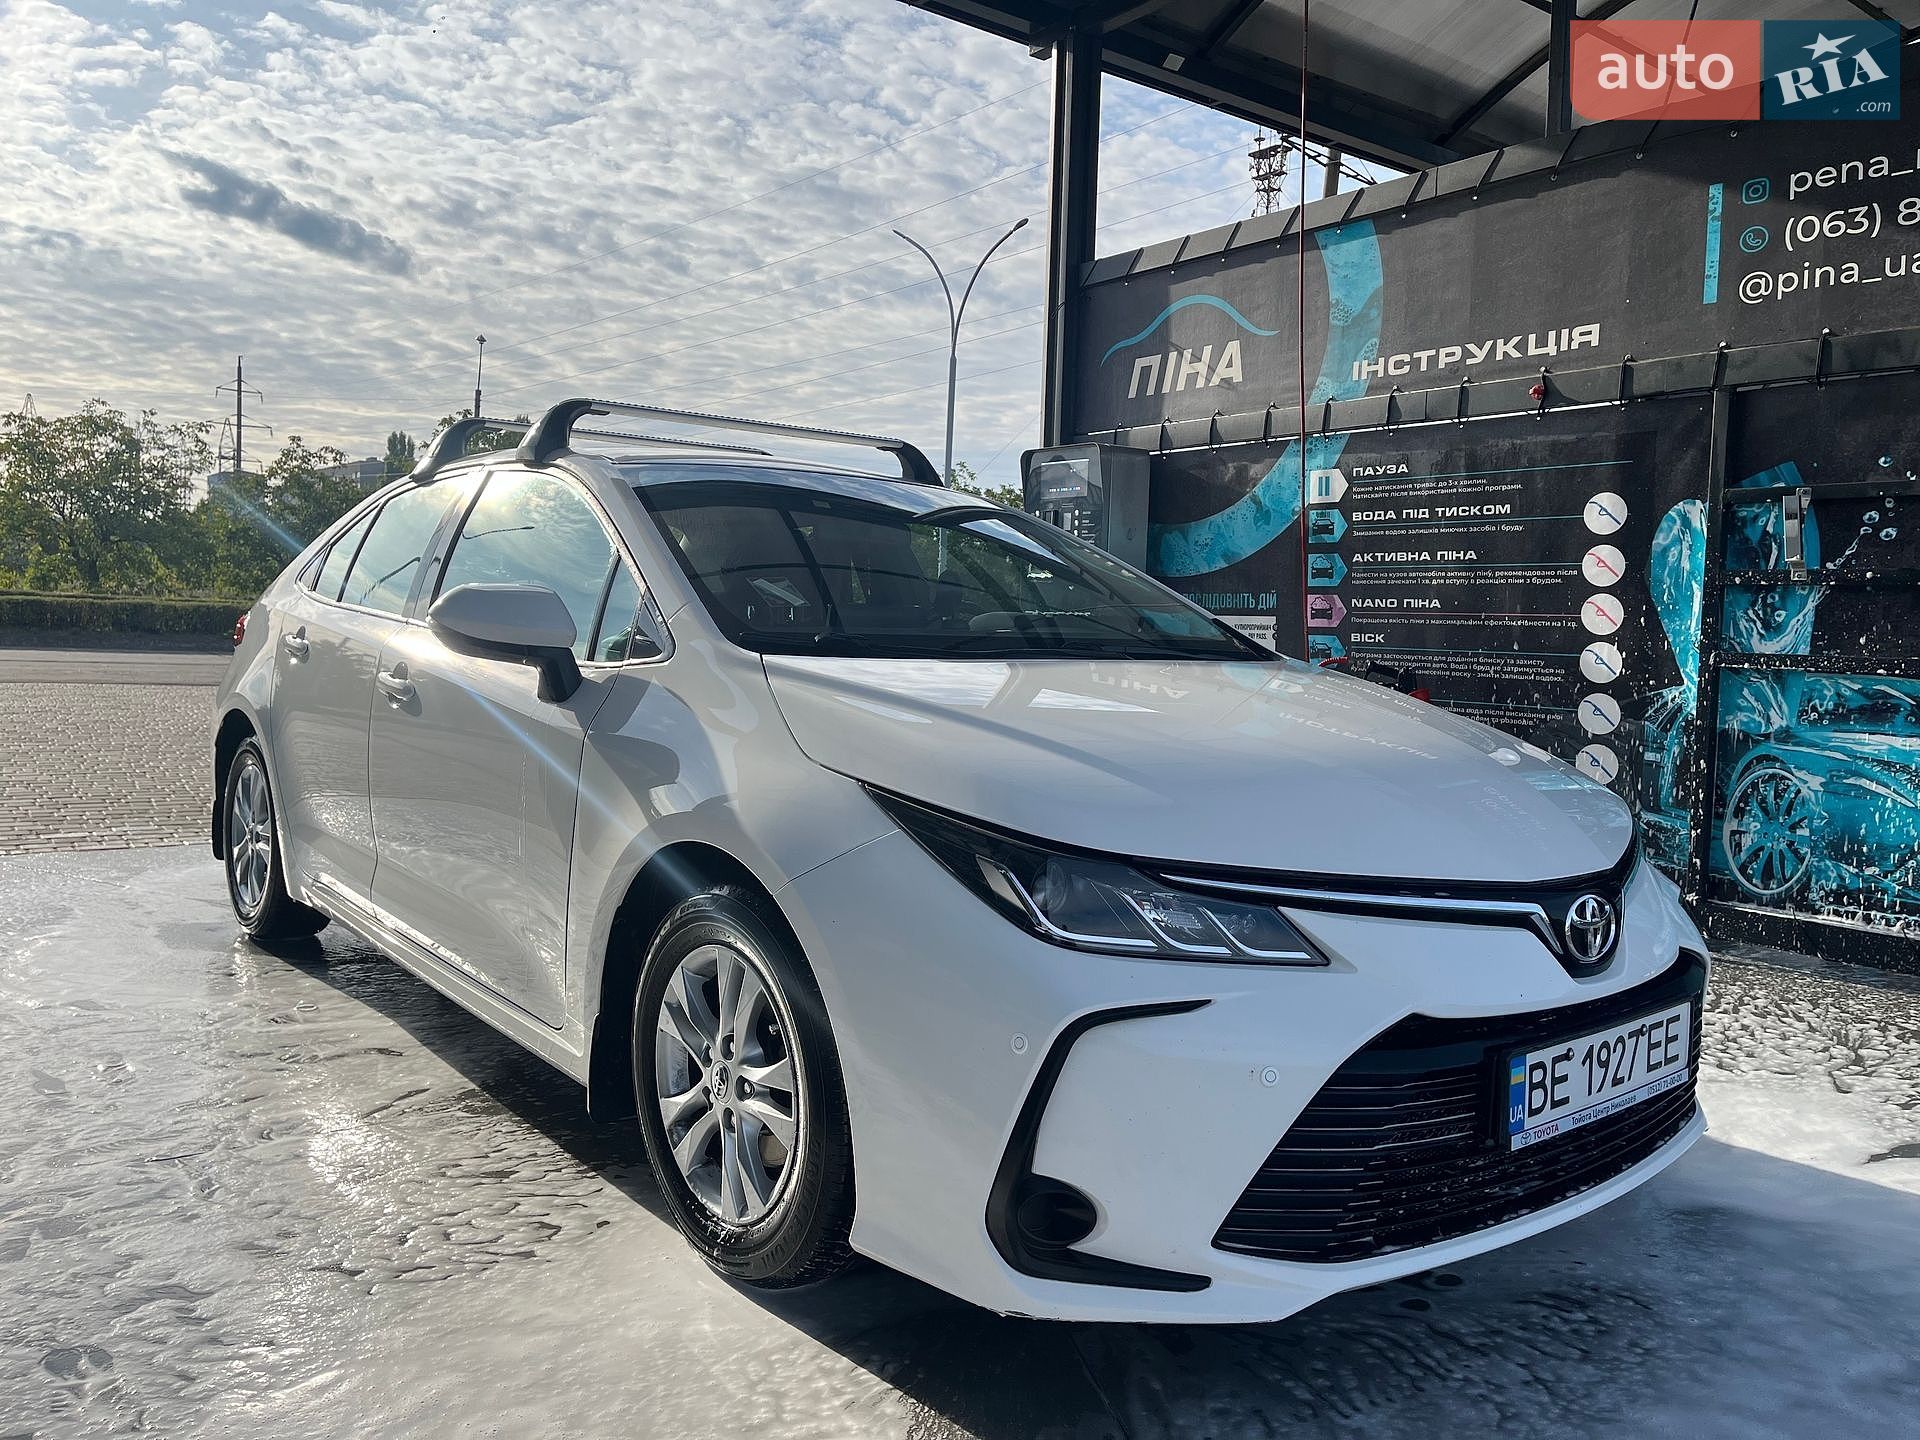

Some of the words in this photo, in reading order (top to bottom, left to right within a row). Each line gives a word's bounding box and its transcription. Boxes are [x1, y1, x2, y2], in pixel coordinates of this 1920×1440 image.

[1789, 147, 1920, 200] pena_
[1784, 203, 1882, 252] (063)
[1352, 323, 1601, 382] ІНСТРУКЦІЯ
[1127, 340, 1243, 399] ПІНА
[1352, 463, 1409, 477] ПАУЗА
[1374, 483, 1412, 492] натискання
[1390, 490, 1408, 498] після
[1409, 487, 1456, 496] використання
[1458, 485, 1484, 494] кожної
[1352, 510, 1397, 521] ВОДА
[1402, 507, 1430, 520] ПІД
[1435, 503, 1511, 518] ТИСКОМ
[1385, 529, 1406, 537] водою
[1407, 527, 1439, 535] залишків
[1440, 526, 1467, 534] миючих
[1469, 525, 1496, 533] засобів
[1352, 551, 1432, 563] АКТИВНА
[1436, 549, 1477, 561] ПІНА
[1408, 570, 1446, 578] автомобіля
[1447, 571, 1475, 580] активну
[1495, 570, 1556, 579] рекомендовано
[1556, 569, 1578, 577] після
[1476, 577, 1507, 586] реакцію
[1507, 577, 1525, 585] піни
[1257, 590, 1277, 610] ДІЙ
[1351, 598, 1398, 608] NANO
[1403, 598, 1441, 609] ПІНА
[1351, 633, 1385, 644] ВІСК
[1351, 651, 1382, 660] Програма
[1383, 653, 1432, 662] застосовується
[1447, 655, 1477, 664] додання
[1478, 656, 1506, 666] блиску
[1515, 659, 1545, 667] захисту
[1450, 663, 1468, 671] Вода
[1472, 663, 1490, 672] бруд
[1502, 666, 1555, 675] затримується
[1451, 671, 1472, 679] воску
[1484, 708, 1504, 717] після
[1528, 1052, 1571, 1118] BE
[1581, 1028, 1641, 1097] 1927
[1647, 1013, 1681, 1073] EE
[1510, 1103, 1524, 1123] UA
[1533, 1123, 1559, 1140] TOYOTA
